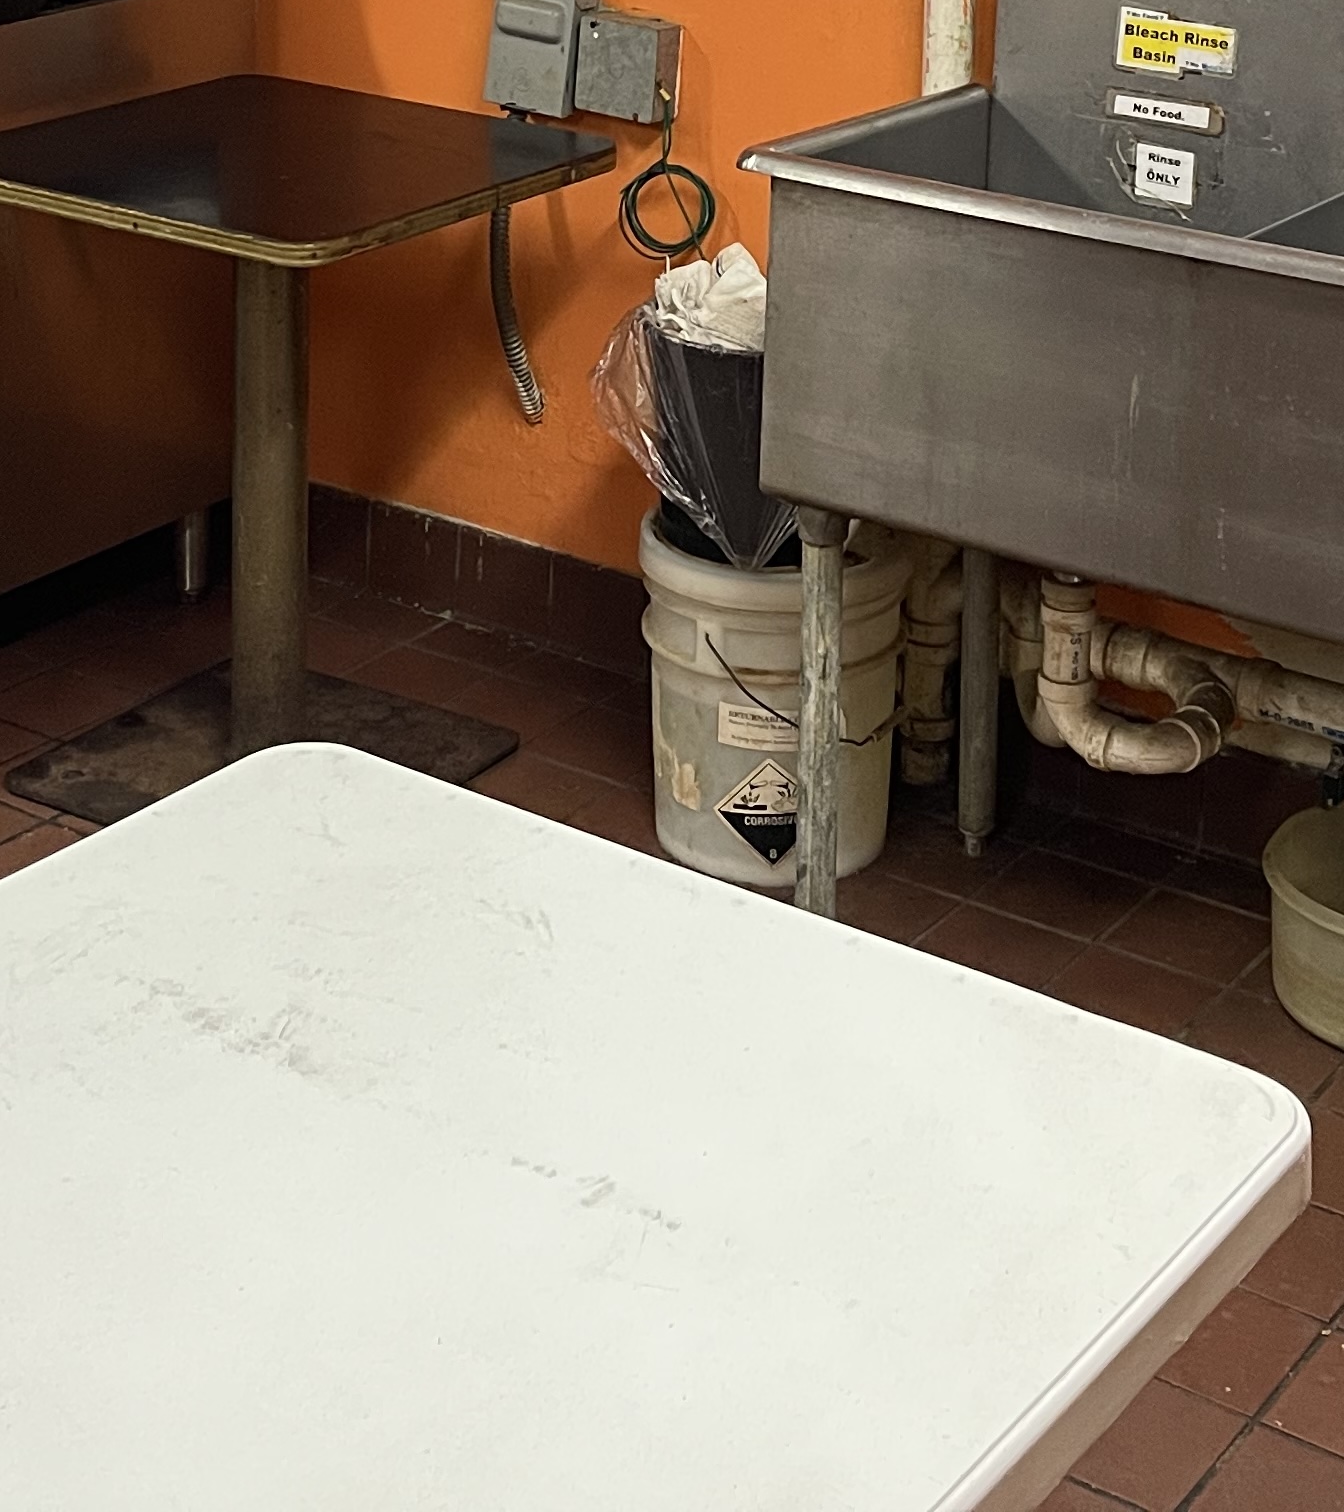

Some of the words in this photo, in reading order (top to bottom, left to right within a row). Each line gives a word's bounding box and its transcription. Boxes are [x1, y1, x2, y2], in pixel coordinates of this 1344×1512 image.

[1124, 23, 1179, 43] Bleach
[1184, 31, 1229, 50] Rinse
[1133, 46, 1176, 65] Basin
[1133, 102, 1149, 114] No
[1152, 106, 1185, 122] Food.
[1147, 152, 1182, 168] Rinse
[1146, 170, 1181, 186] ONLY
[744, 815, 797, 827] CORROSIV
[769, 848, 778, 860] 8
